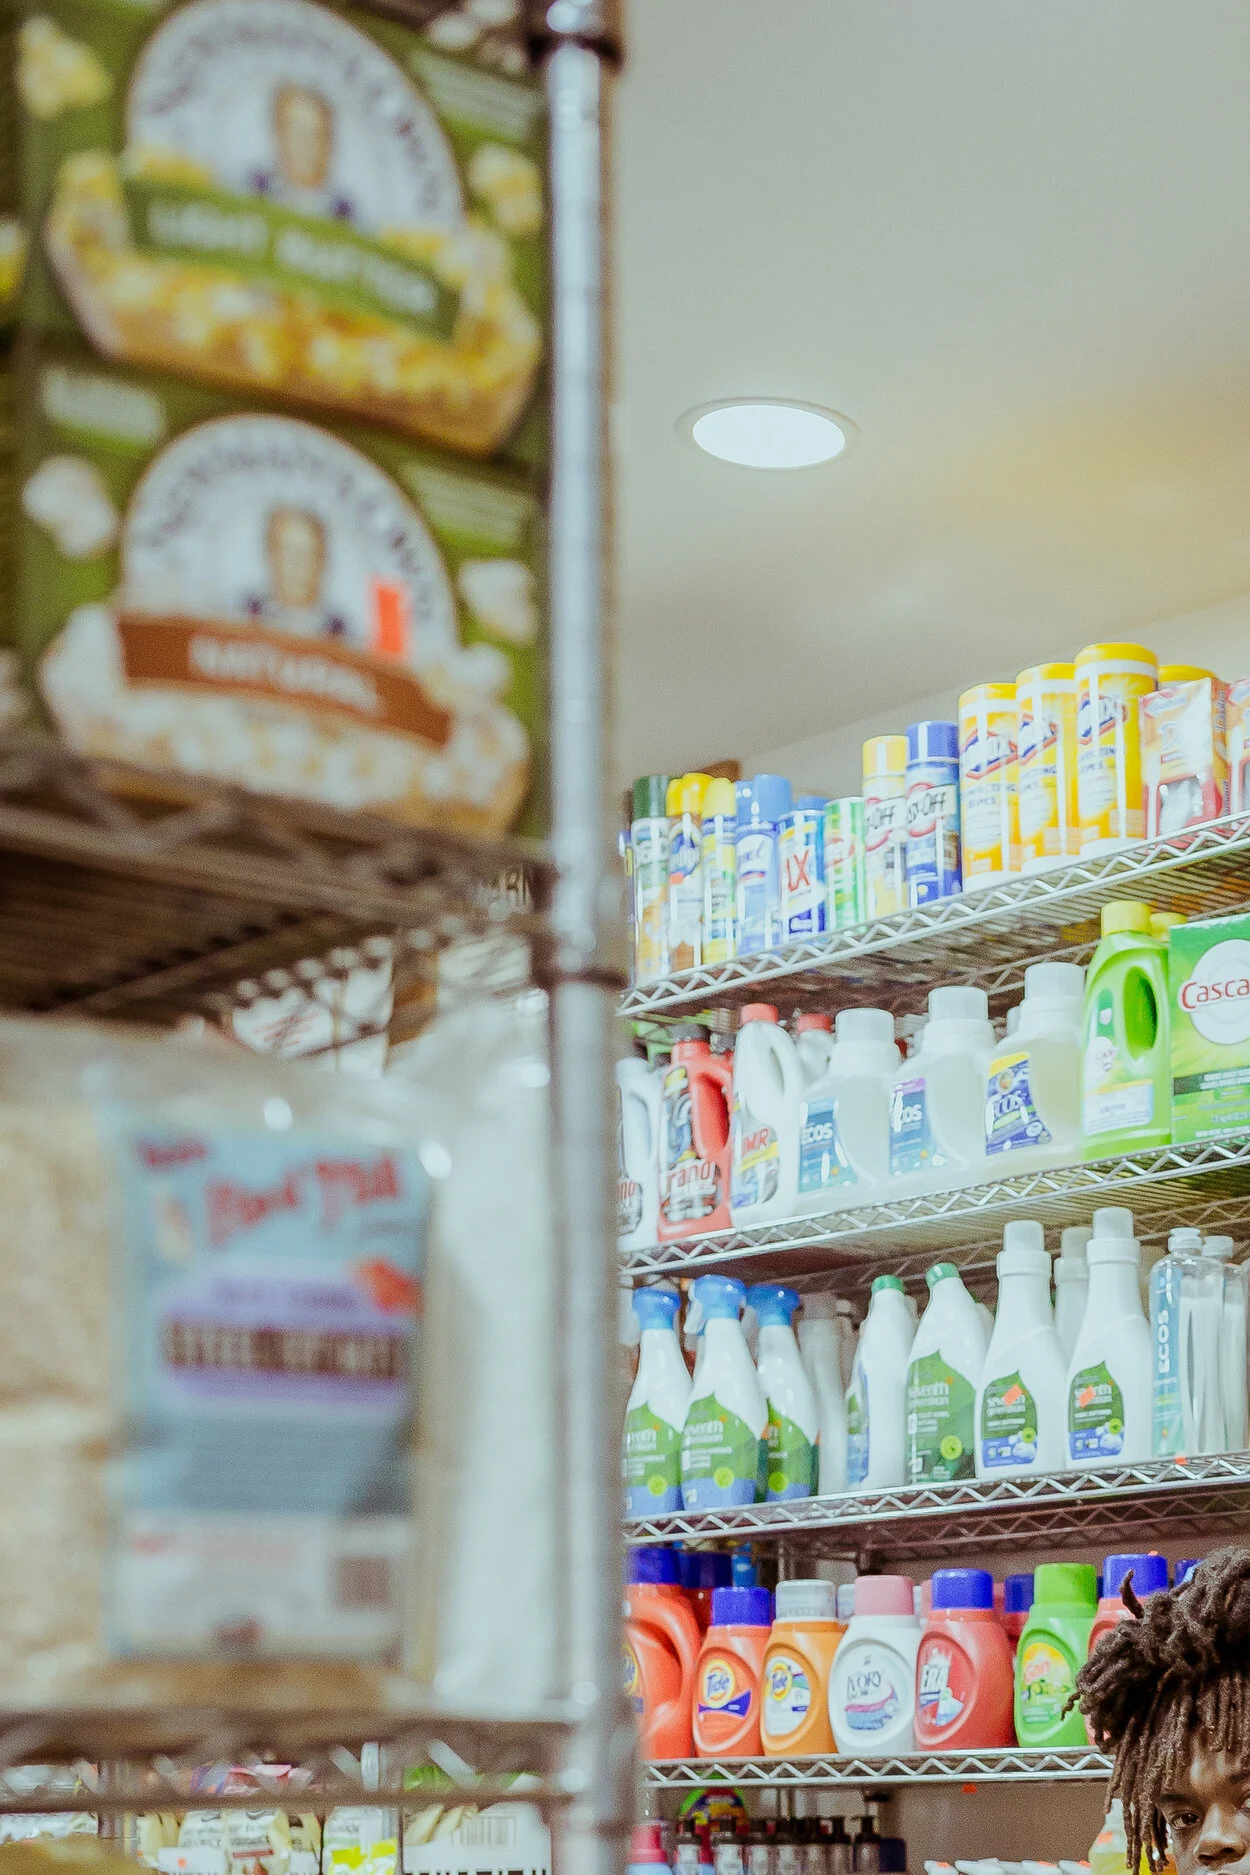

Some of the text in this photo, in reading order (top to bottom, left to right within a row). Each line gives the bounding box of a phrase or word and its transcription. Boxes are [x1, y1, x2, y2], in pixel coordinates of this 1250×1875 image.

[666, 1161, 711, 1198] rano
[1158, 1309, 1170, 1373] ECOS
[707, 1673, 730, 1697] Tide
[772, 1673, 789, 1690] Tide
